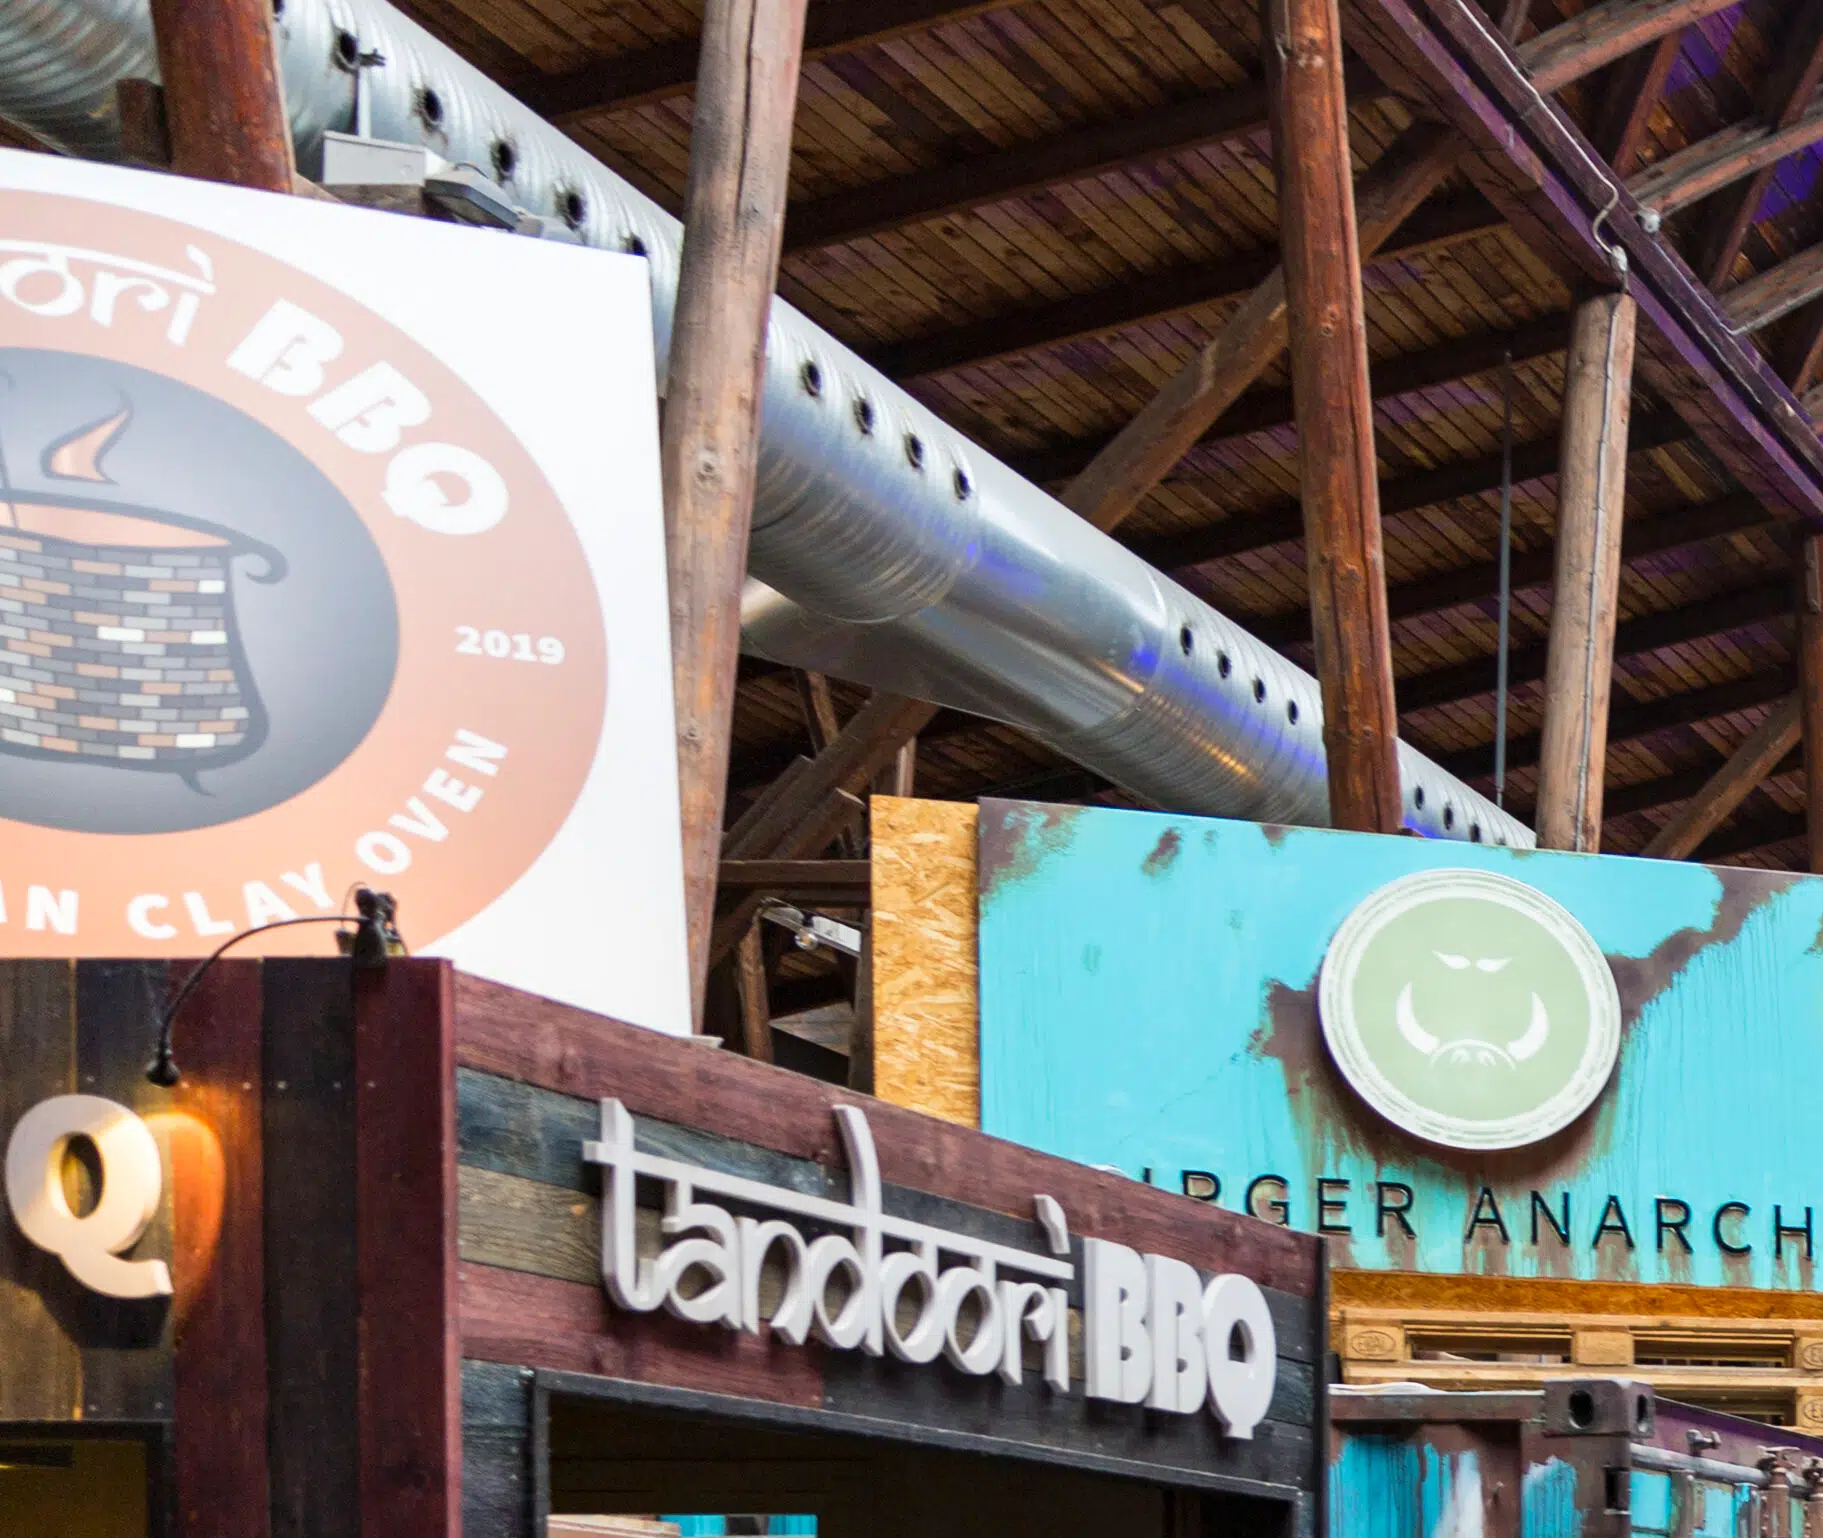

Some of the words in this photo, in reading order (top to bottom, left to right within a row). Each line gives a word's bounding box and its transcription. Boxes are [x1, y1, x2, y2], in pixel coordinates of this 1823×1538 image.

[225, 297, 510, 536] BBQ
[454, 624, 566, 665] 2019
[127, 862, 336, 942] CLAY
[355, 727, 510, 876] OVEN
[5, 1094, 174, 1299] Q
[582, 1096, 1075, 1395] tandoori
[1084, 1236, 1278, 1441] BBQ
